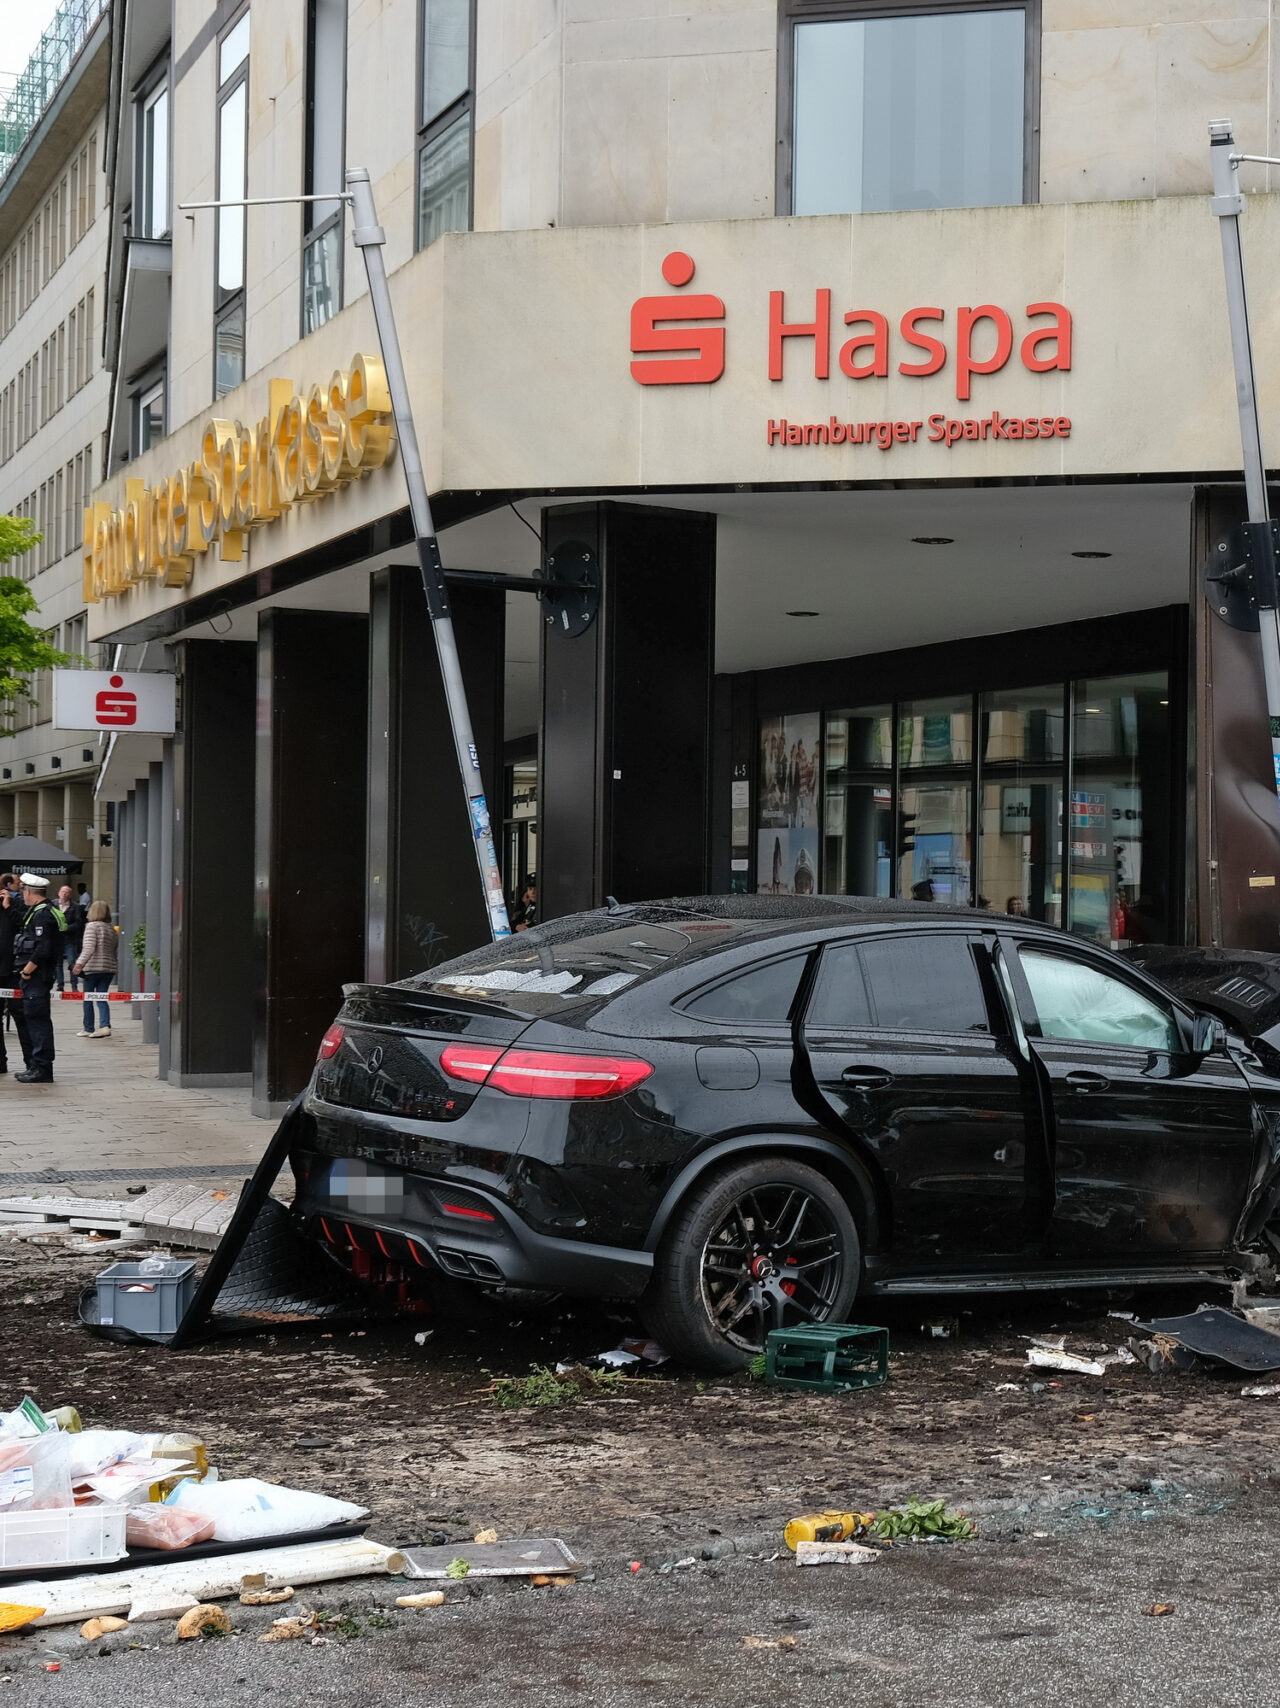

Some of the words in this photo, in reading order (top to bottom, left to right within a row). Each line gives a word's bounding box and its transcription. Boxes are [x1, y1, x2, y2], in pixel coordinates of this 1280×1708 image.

[767, 288, 1074, 401] Haspa
[767, 415, 924, 450] Hamburger
[926, 411, 1073, 447] Sparkasse
[83, 460, 208, 604] Hamburger
[202, 352, 393, 562] Sparkasse
[12, 864, 67, 874] frittenwerk
